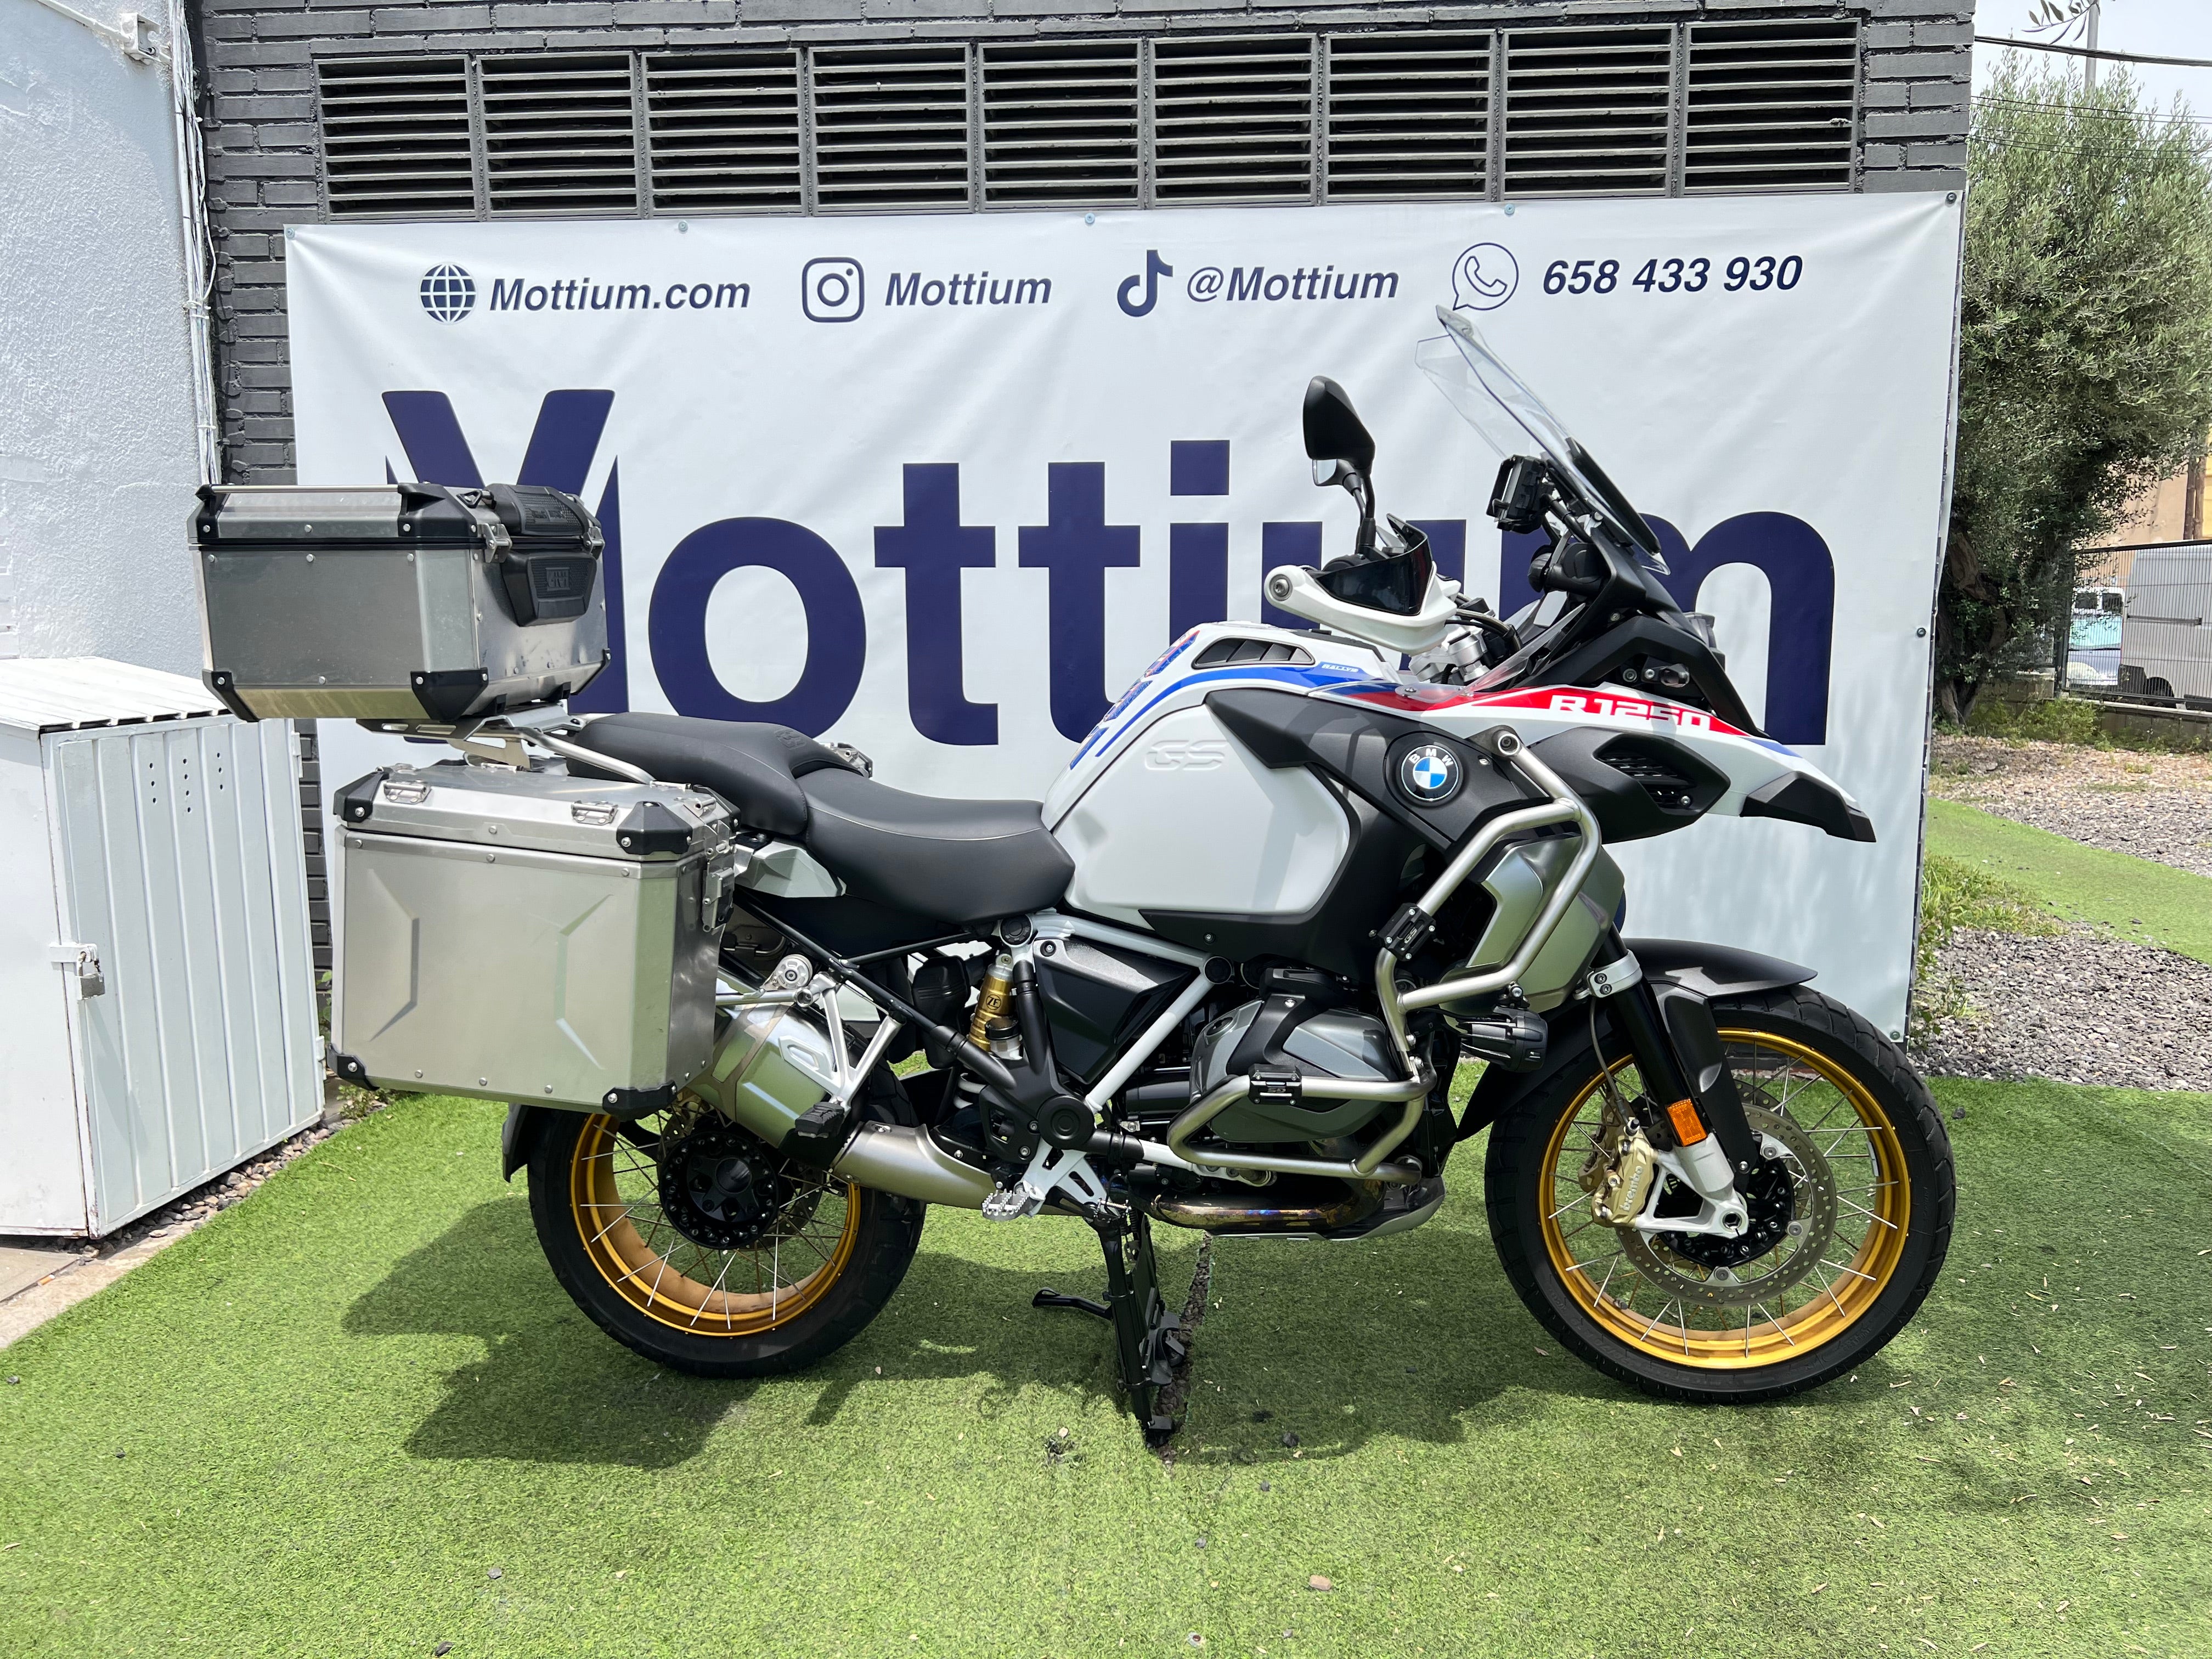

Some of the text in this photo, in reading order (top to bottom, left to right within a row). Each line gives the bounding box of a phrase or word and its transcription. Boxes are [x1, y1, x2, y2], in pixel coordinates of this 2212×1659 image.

[885, 271, 1051, 306] Mottium
[1187, 266, 1399, 303] @Mottium
[1543, 255, 1803, 295] 658 433 930
[490, 278, 749, 311] Mottium.com
[1144, 740, 1226, 770] GS
[1408, 748, 1454, 767] BMW
[987, 995, 1001, 1008] ZF
[1620, 1165, 1642, 1211] brembo
